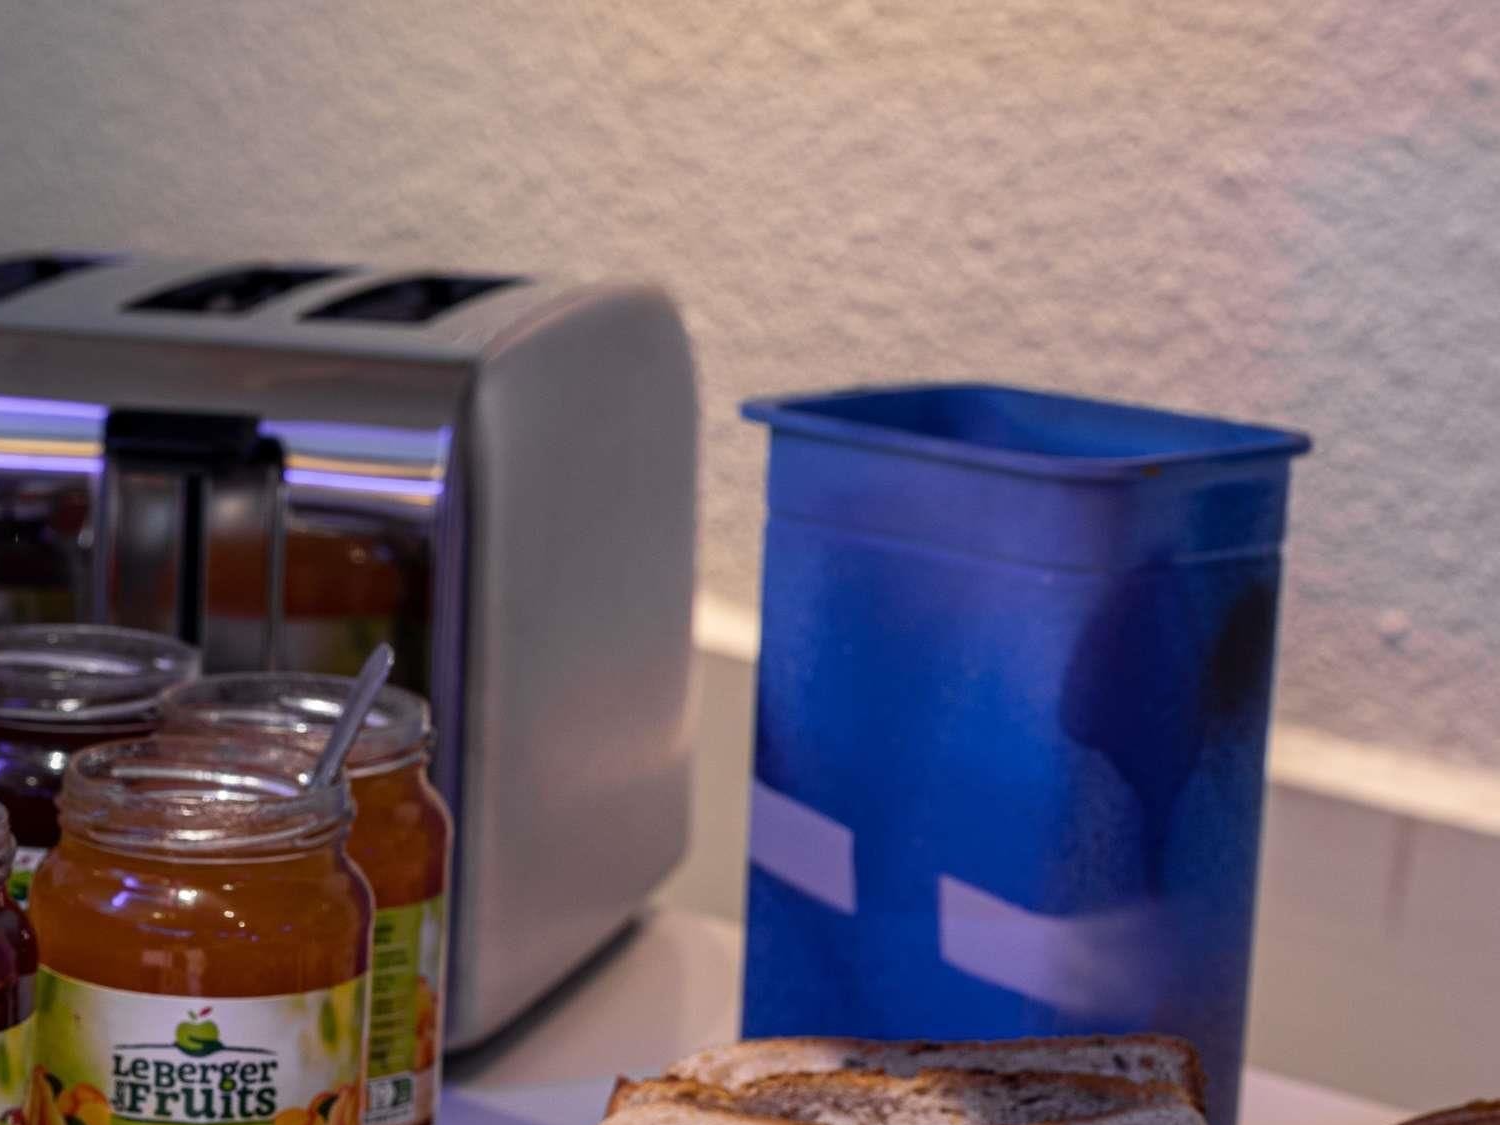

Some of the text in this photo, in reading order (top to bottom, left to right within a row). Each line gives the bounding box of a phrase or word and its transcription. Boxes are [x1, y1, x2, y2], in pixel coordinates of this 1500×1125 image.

[112, 1055, 277, 1092] Le Berger
[127, 1082, 277, 1118] Fruits
